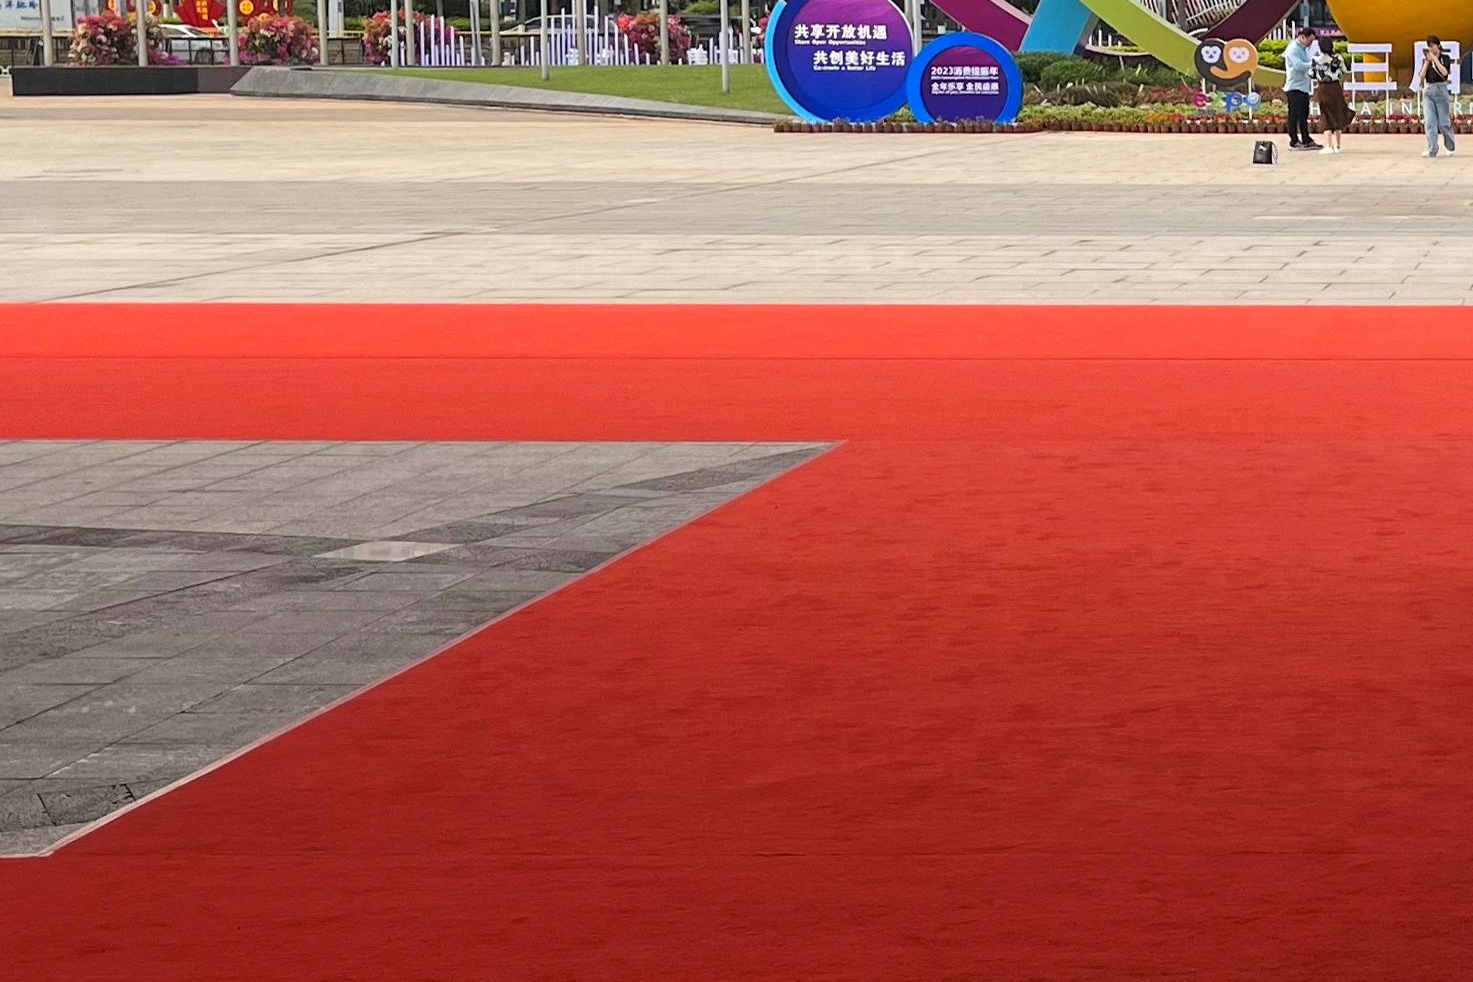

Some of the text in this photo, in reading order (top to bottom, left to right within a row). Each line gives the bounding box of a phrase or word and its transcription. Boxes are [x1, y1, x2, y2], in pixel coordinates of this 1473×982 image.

[794, 24, 888, 40] 共享开放机遇
[813, 50, 906, 66] 共创美好生活
